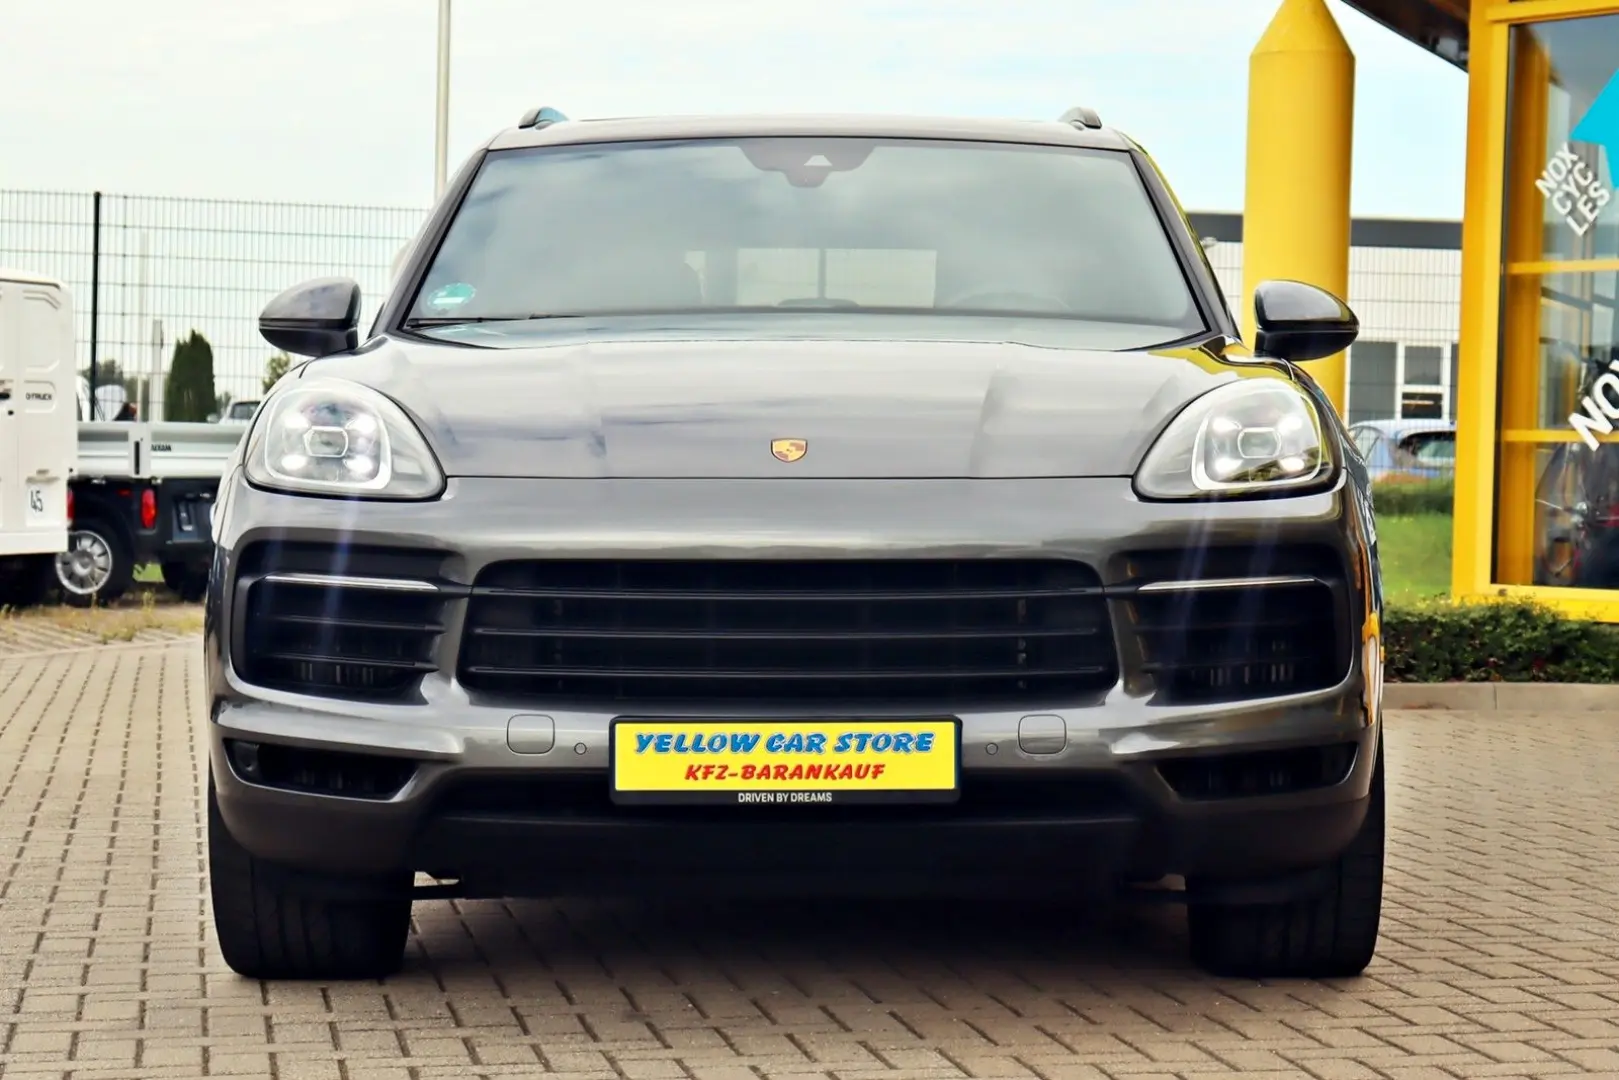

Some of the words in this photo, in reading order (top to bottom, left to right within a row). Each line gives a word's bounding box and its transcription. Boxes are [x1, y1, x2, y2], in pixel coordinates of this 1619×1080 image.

[1535, 142, 1579, 198] NOX
[1552, 162, 1592, 216] CYC
[1566, 181, 1611, 237] LES
[1568, 359, 1619, 452] NO
[635, 732, 761, 754] YELLOW
[765, 732, 827, 754] CAR
[833, 732, 935, 754] STORE
[684, 763, 886, 781] KFZ-BARANKAUF
[738, 792, 774, 803] DRIVEN
[776, 792, 789, 803] BY
[790, 792, 833, 803] DREAMS
